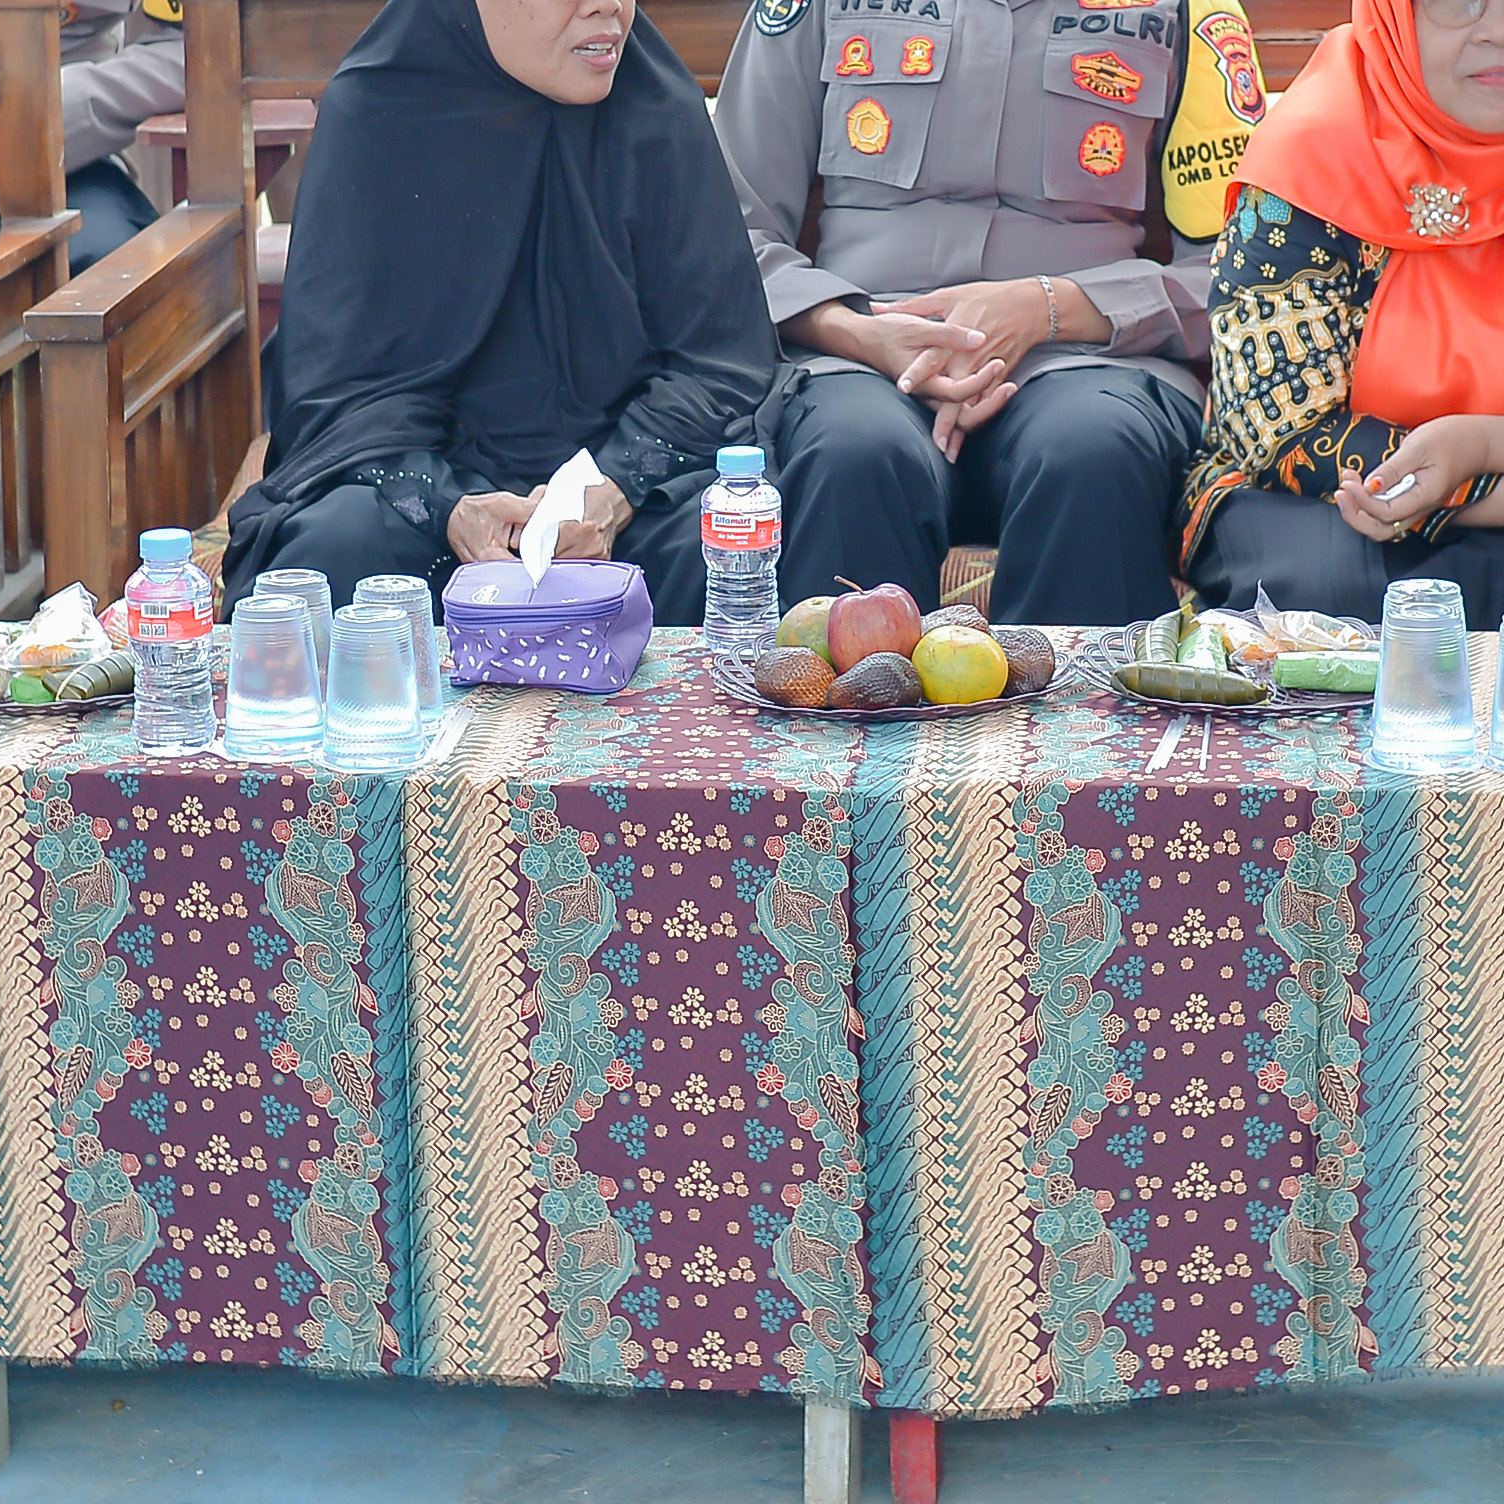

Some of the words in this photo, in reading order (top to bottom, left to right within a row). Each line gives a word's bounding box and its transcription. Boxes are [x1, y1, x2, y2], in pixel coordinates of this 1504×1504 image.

[1052, 12, 1176, 48] POLRI
[1177, 167, 1212, 186] OMB
[714, 516, 752, 526] Alfamart
